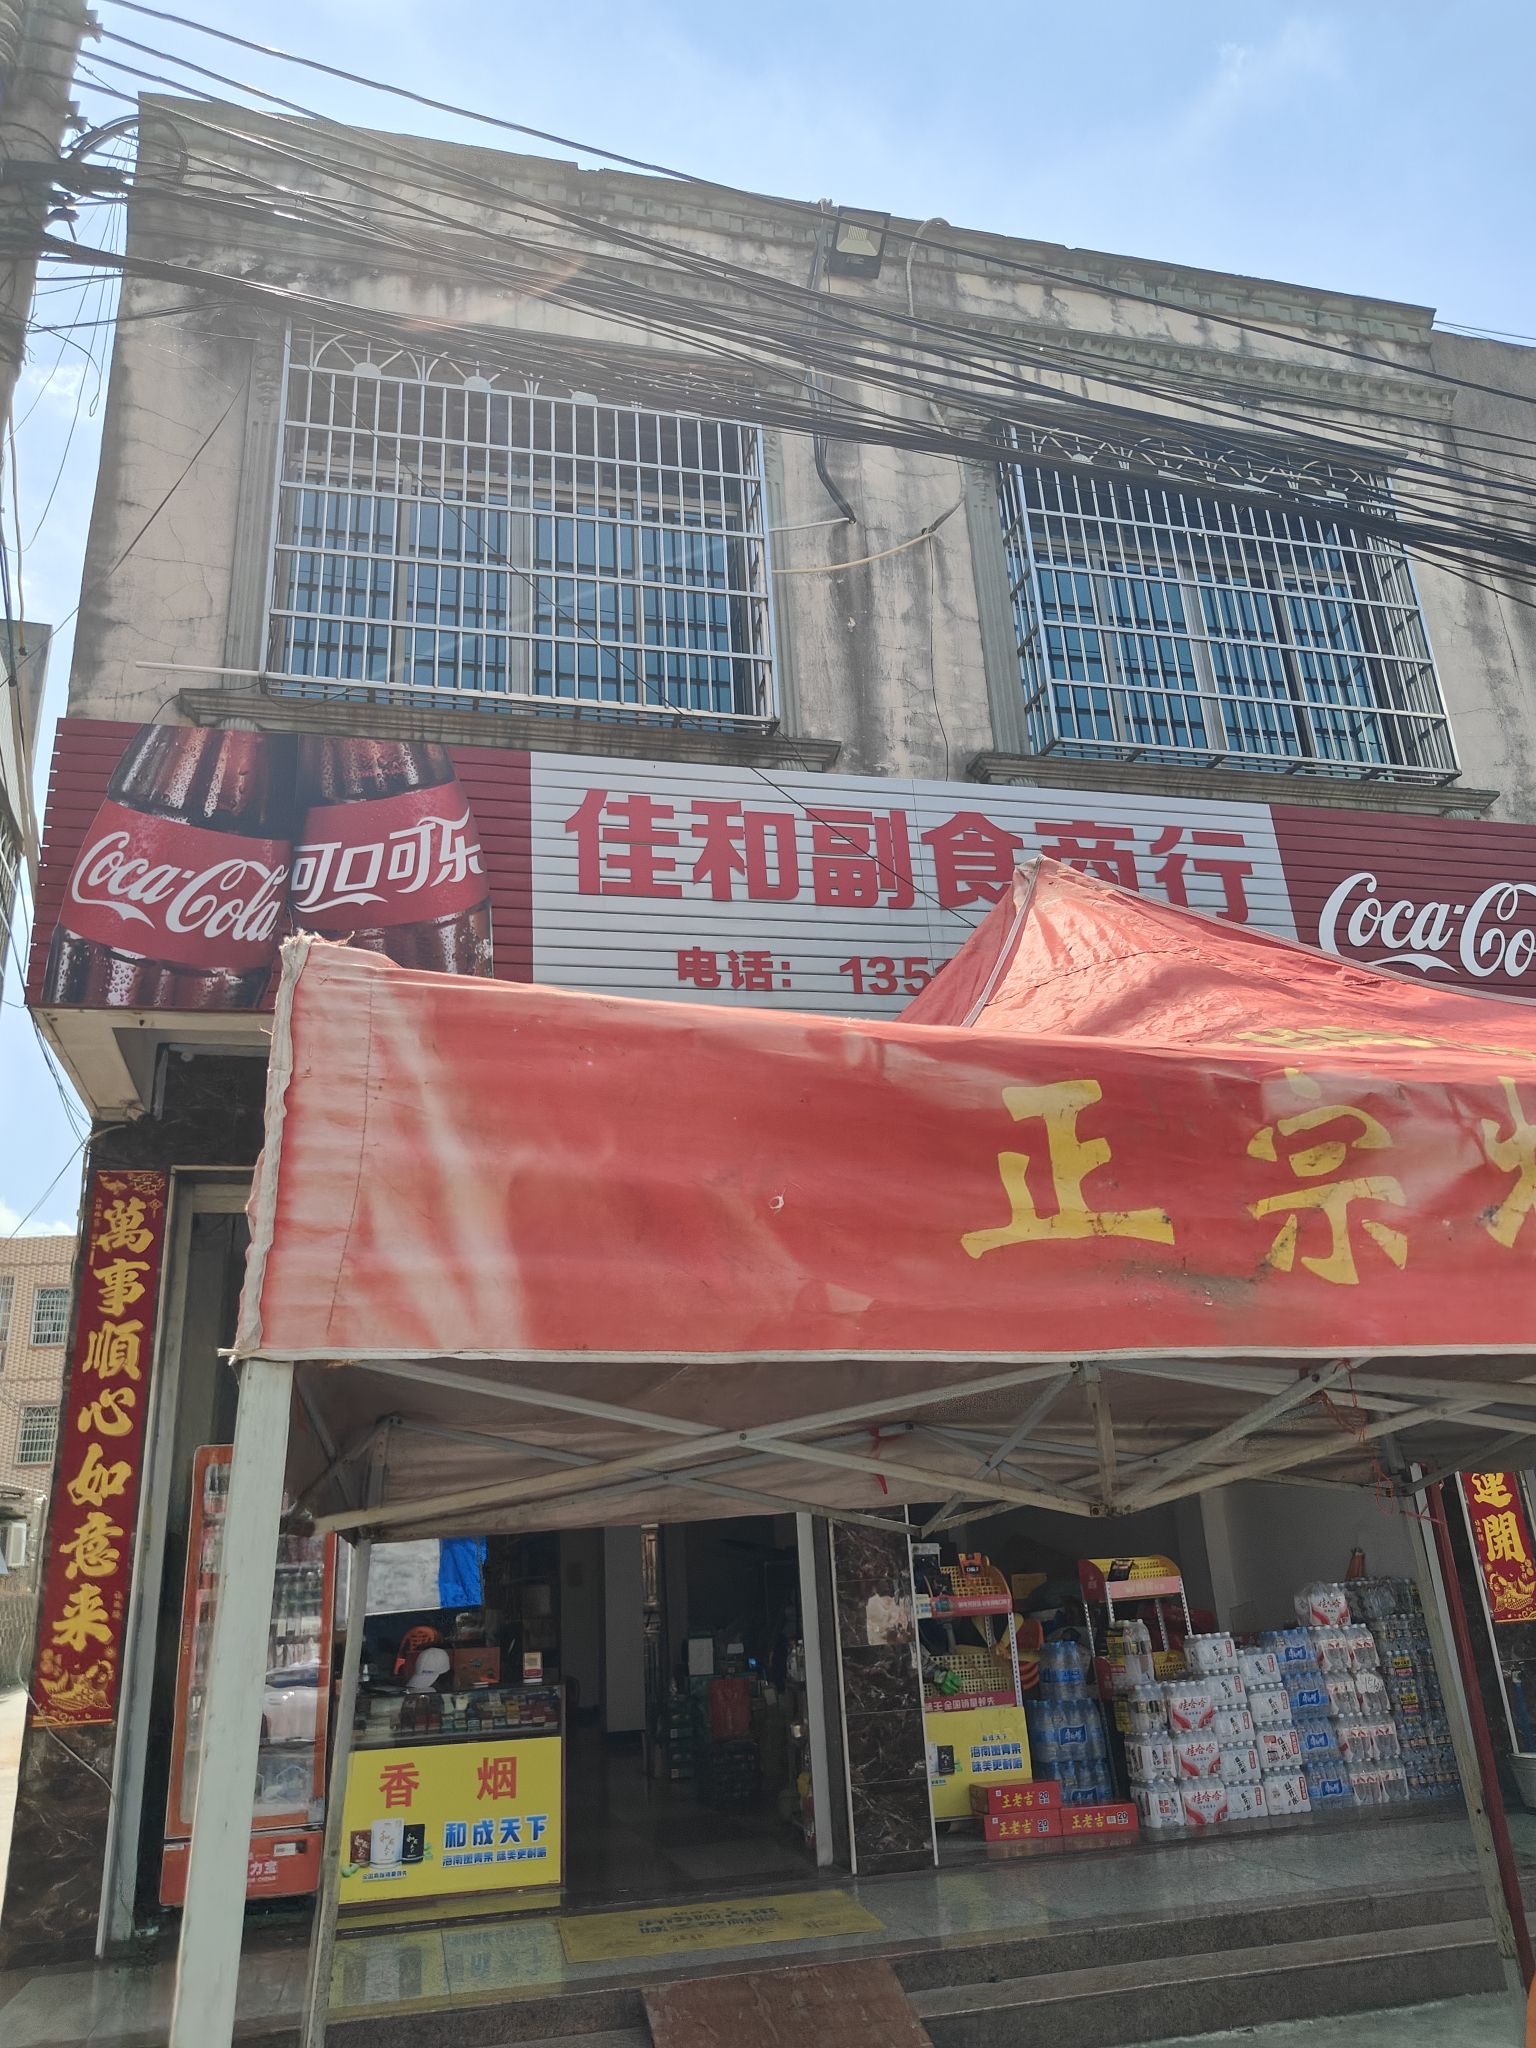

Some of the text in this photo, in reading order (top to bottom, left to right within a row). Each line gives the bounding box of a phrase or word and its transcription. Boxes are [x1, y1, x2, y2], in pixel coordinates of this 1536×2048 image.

[291, 806, 485, 912] 可口可乐
[564, 788, 1253, 924] 佳和副食商行
[72, 831, 290, 942] Coca-Cola
[379, 1756, 517, 1808] 香烟
[1001, 1791, 1034, 1808] 王老吉
[445, 1815, 547, 1848] 和成天下
[999, 1819, 1032, 1835] 王老吉
[1072, 1812, 1104, 1829] 王老吉
